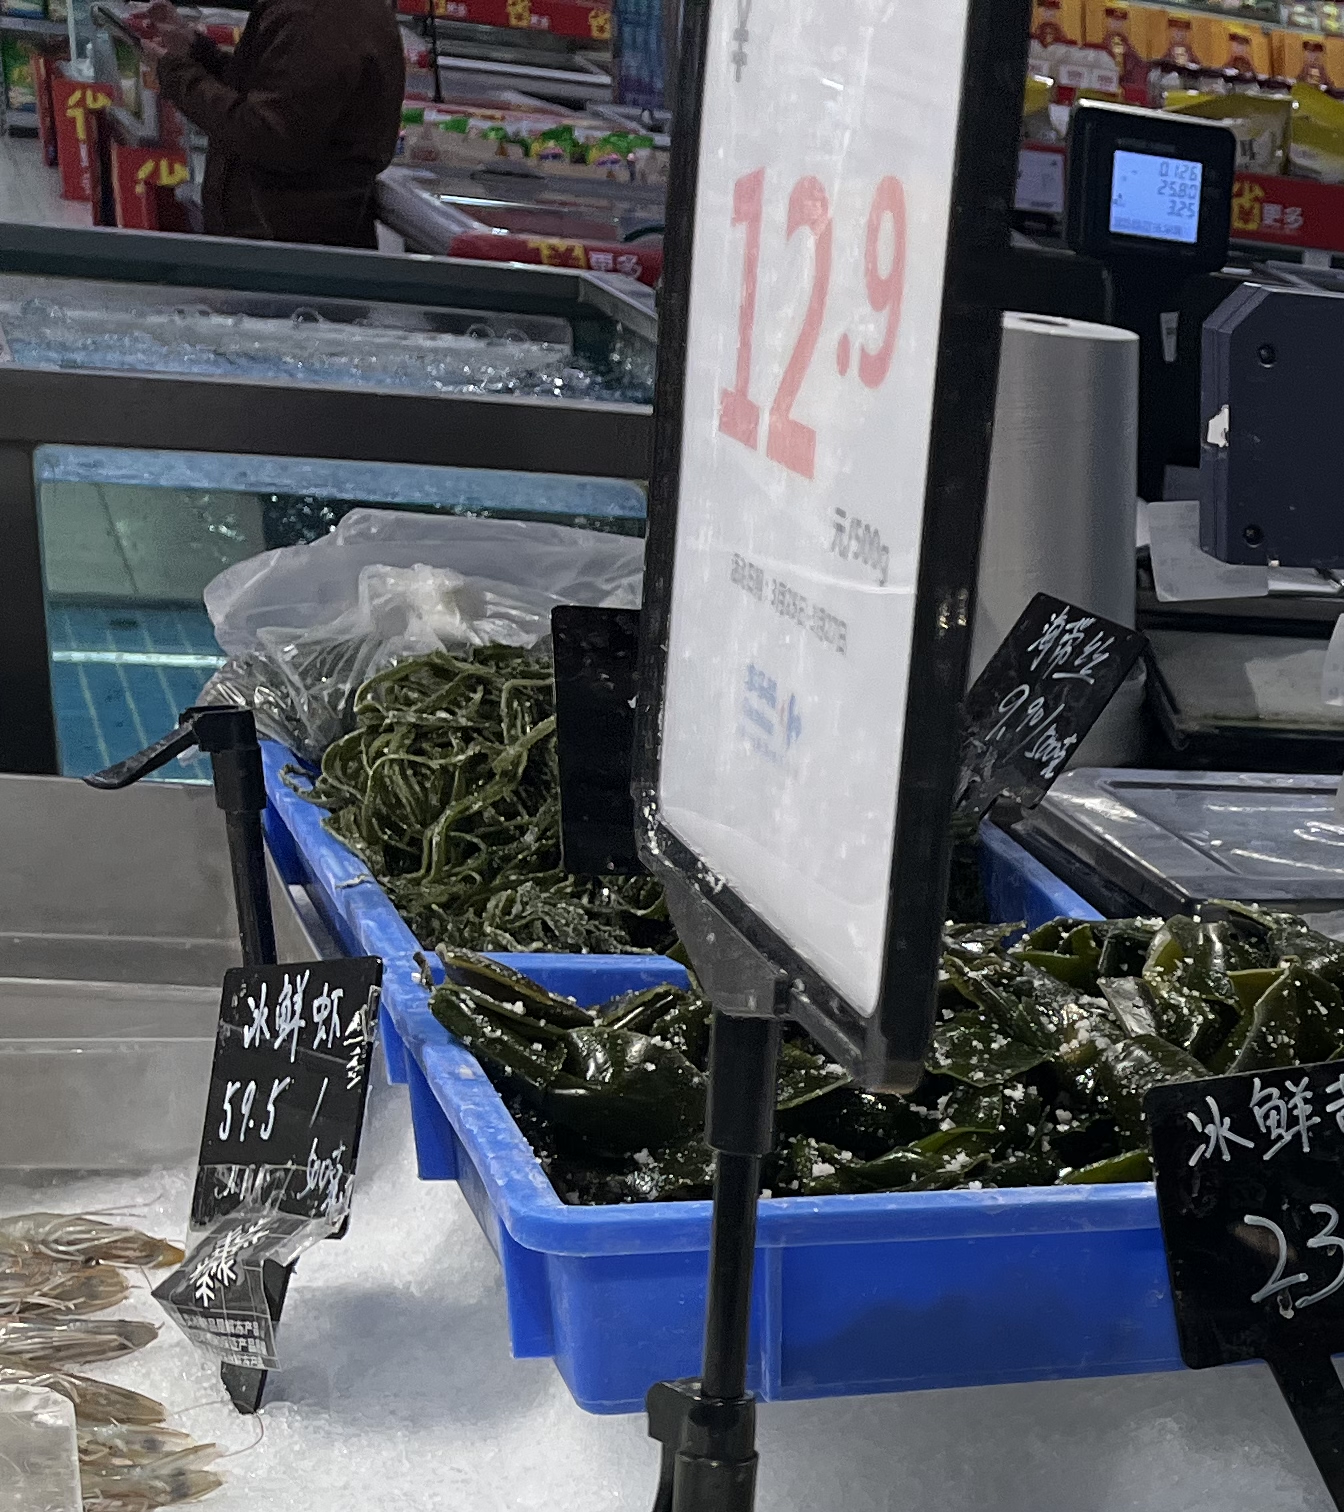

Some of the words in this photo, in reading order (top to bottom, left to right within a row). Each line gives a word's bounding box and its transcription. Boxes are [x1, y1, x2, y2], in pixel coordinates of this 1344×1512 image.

[718, 166, 908, 480] 12.9
[243, 969, 344, 1063] 冰鲜虾
